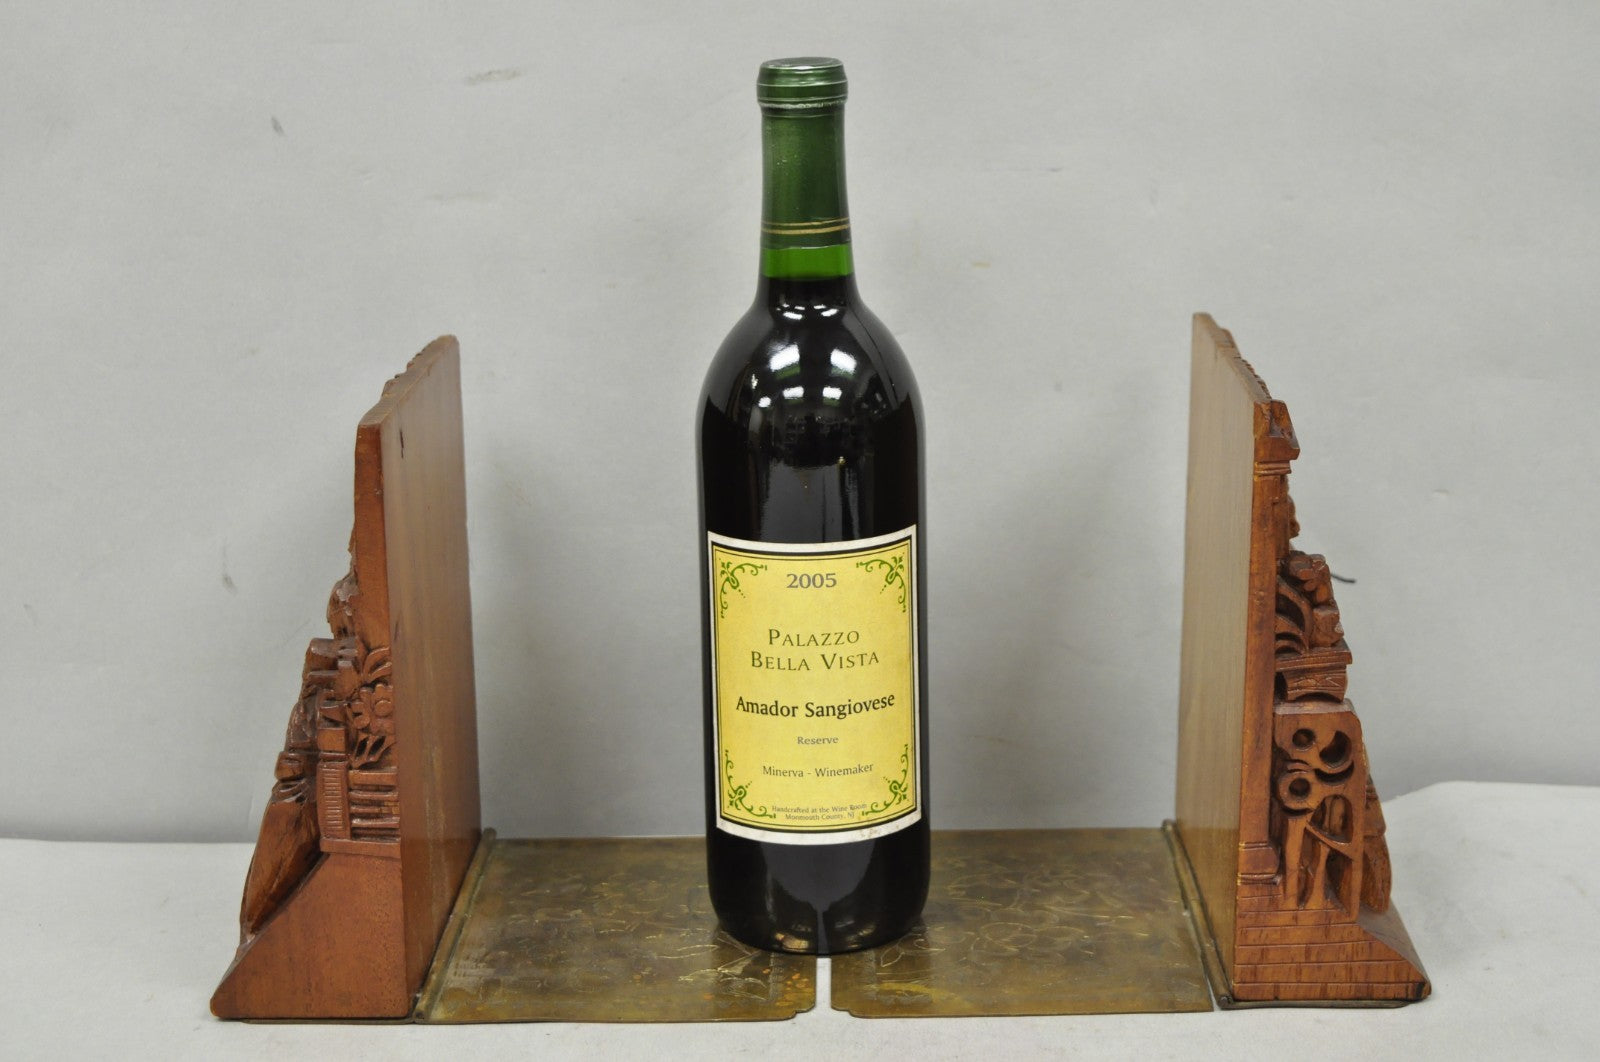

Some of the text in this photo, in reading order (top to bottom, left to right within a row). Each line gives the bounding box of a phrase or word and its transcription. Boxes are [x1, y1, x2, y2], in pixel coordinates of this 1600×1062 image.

[786, 573, 837, 589] 2005
[768, 628, 860, 647] PALAZZO
[751, 651, 880, 671] BELLA VISTA
[736, 694, 895, 719] Amador Sangiovese
[797, 736, 839, 745] Reserve
[762, 765, 804, 777] Minerva
[815, 764, 874, 777] Winemaker
[772, 805, 809, 813] Handcrafted
